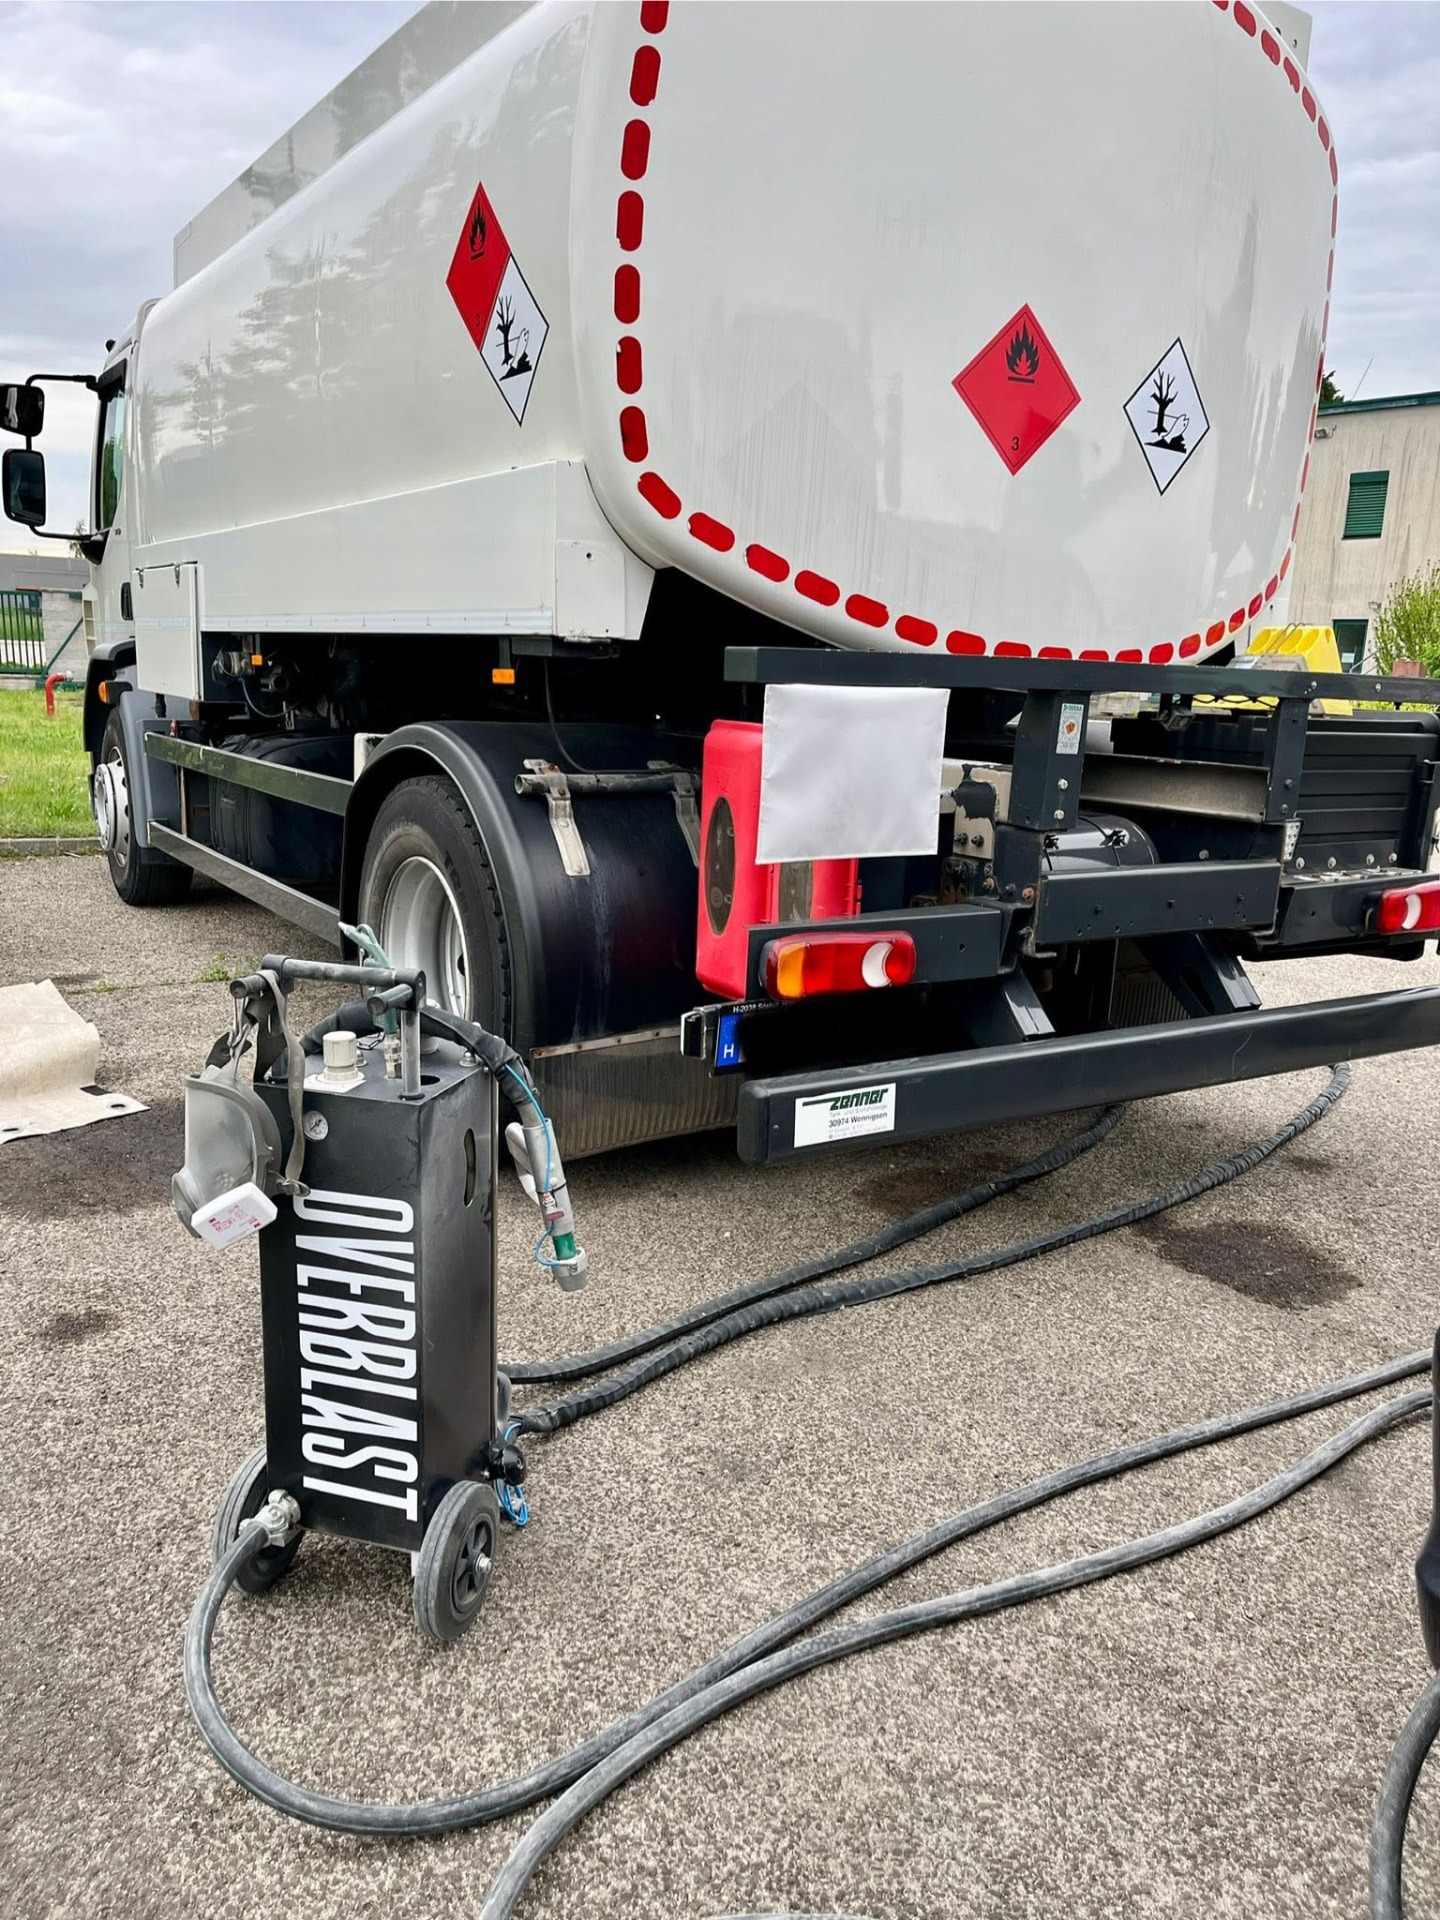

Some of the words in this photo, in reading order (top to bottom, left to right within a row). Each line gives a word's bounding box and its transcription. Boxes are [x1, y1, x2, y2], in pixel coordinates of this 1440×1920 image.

[1011, 436, 1020, 451] 3
[723, 1043, 734, 1059] H
[829, 1117, 849, 1128] 30974
[850, 1112, 888, 1124] Wennigsen
[293, 1188, 419, 1522] OVERBLAST
